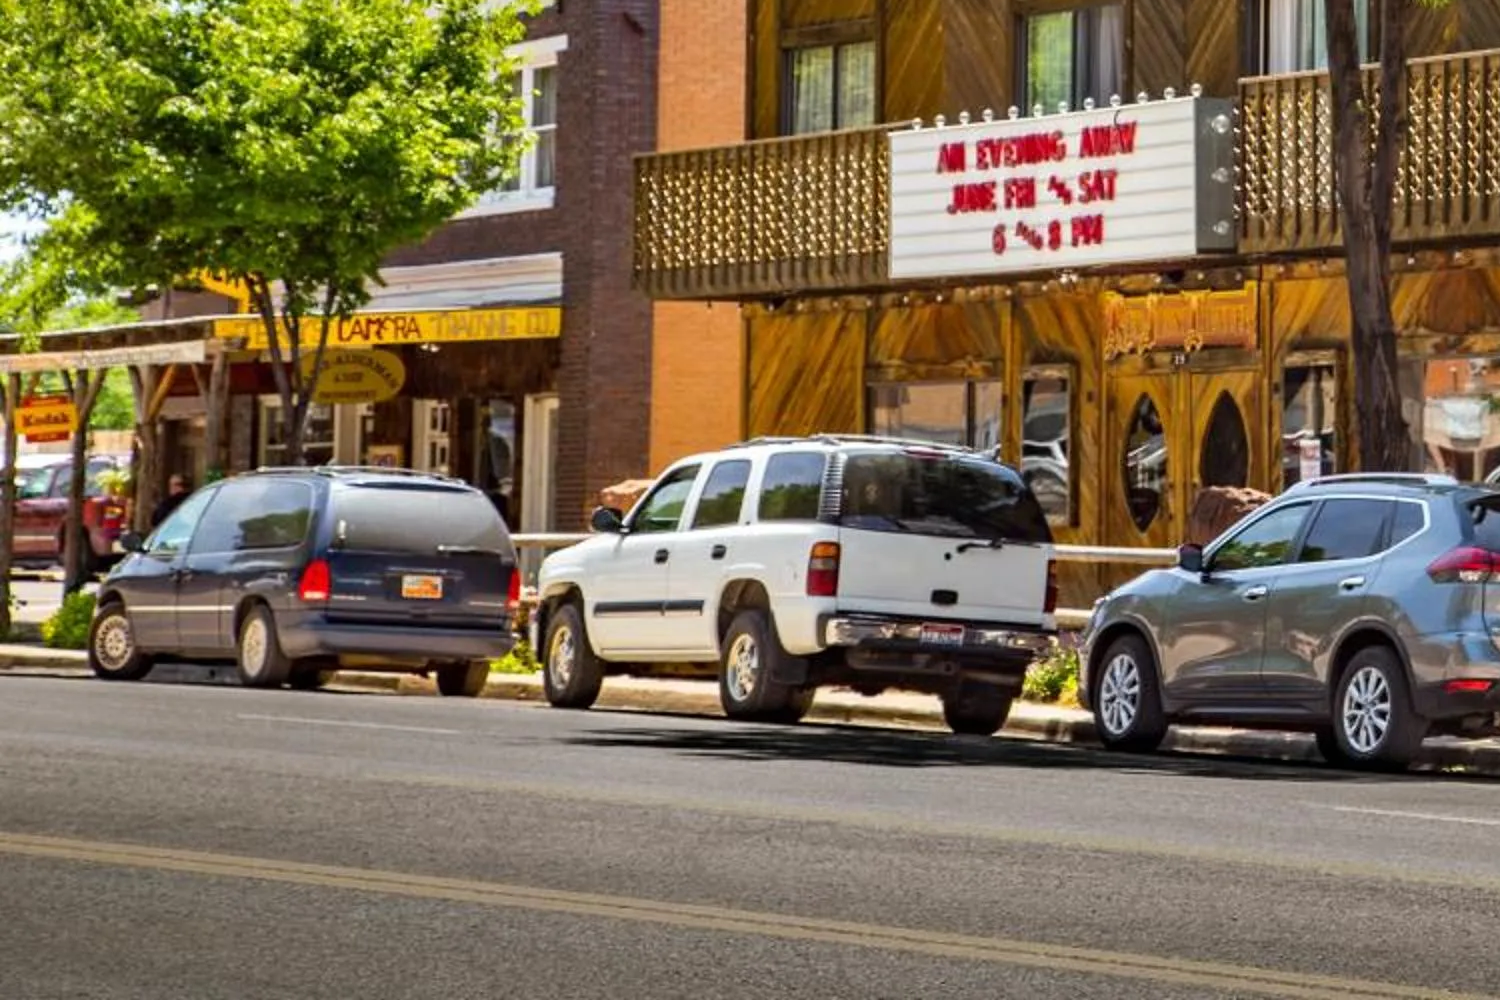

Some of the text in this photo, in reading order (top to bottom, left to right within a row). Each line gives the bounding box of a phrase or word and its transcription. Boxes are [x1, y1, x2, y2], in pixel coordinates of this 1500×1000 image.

[976, 131, 1066, 170] EVENING
[1078, 169, 1118, 204] SAT
[1071, 214, 1104, 247] PM
